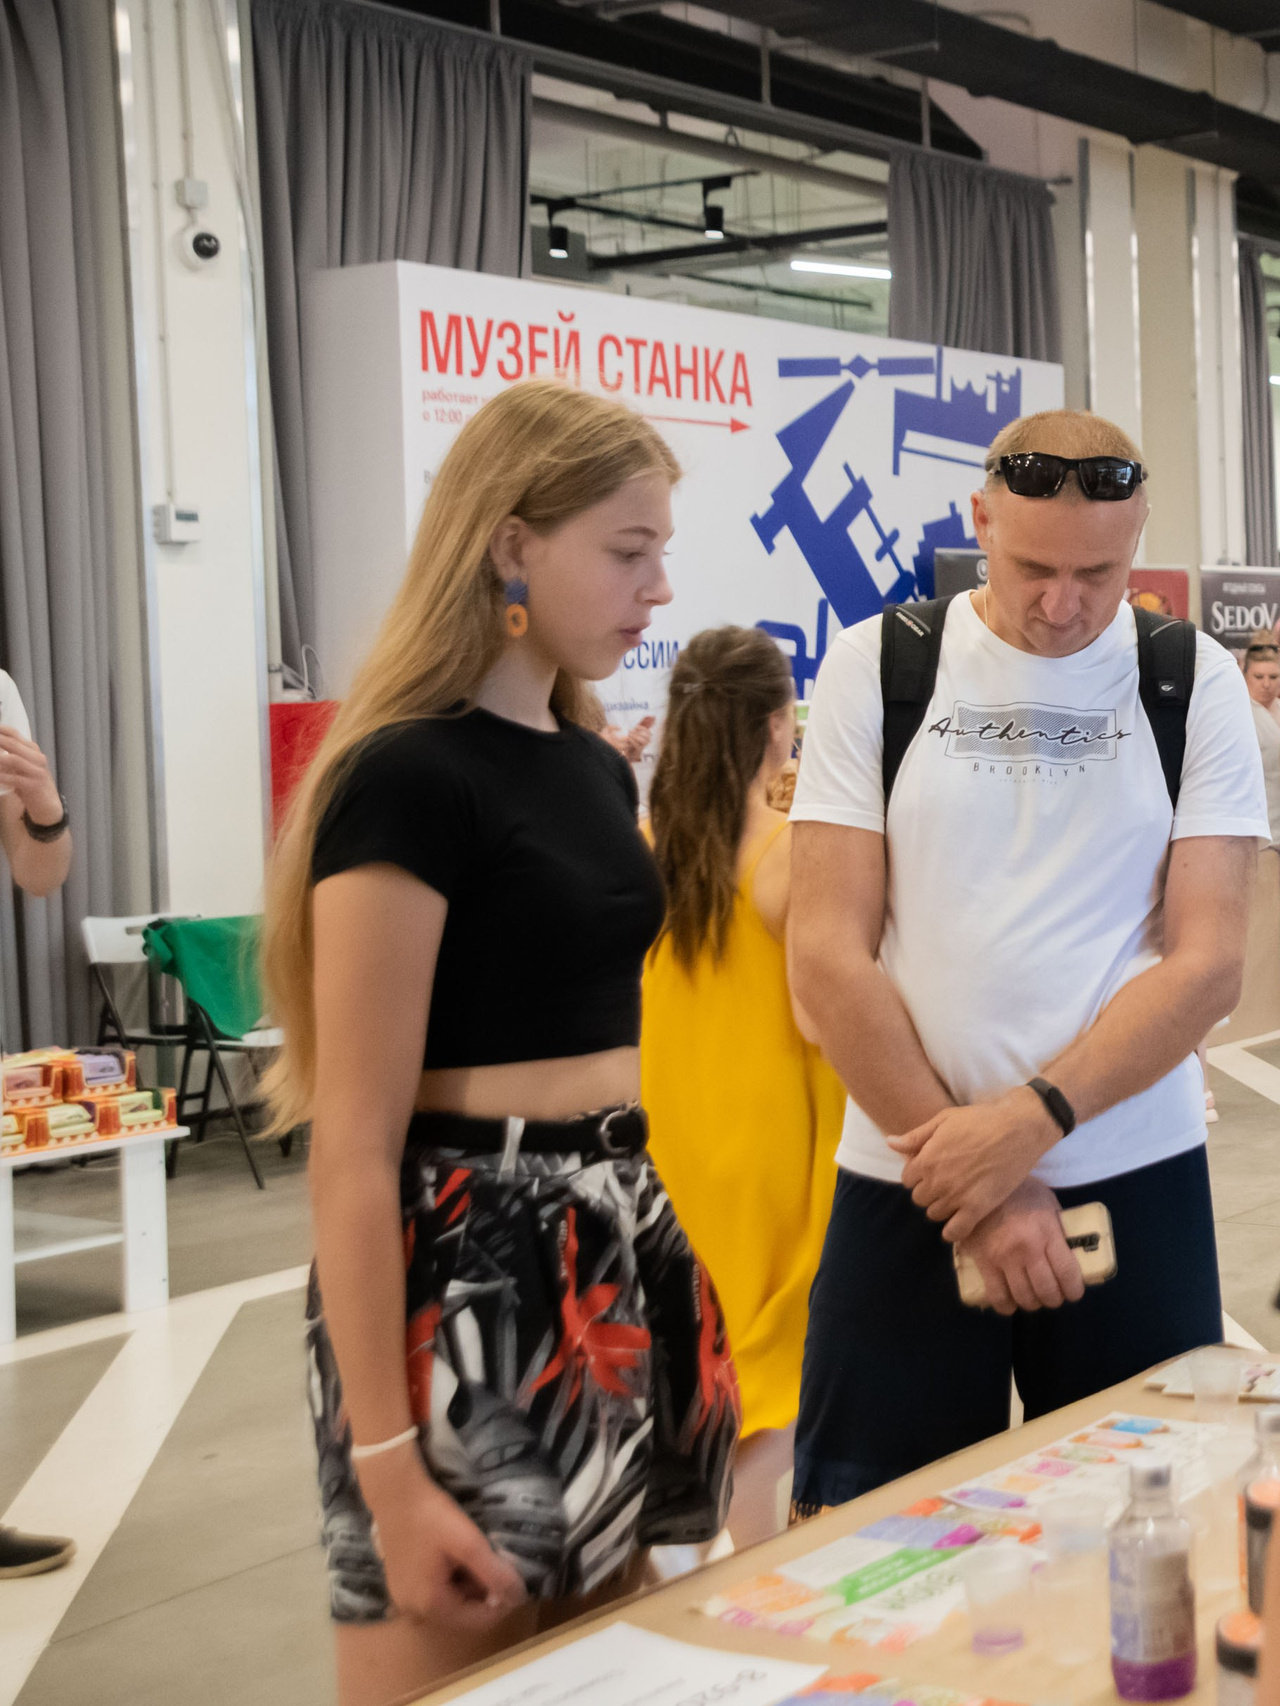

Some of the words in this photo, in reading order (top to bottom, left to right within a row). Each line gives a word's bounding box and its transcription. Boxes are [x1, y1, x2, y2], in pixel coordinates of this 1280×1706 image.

[420, 309, 581, 386] МУЗЕЙ
[598, 333, 753, 407] СТАНКА
[1210, 601, 1278, 634] SEDOV
[622, 640, 680, 669] ССИИ
[928, 717, 1132, 745] Authentics
[973, 762, 1085, 777] BROOKLYN
